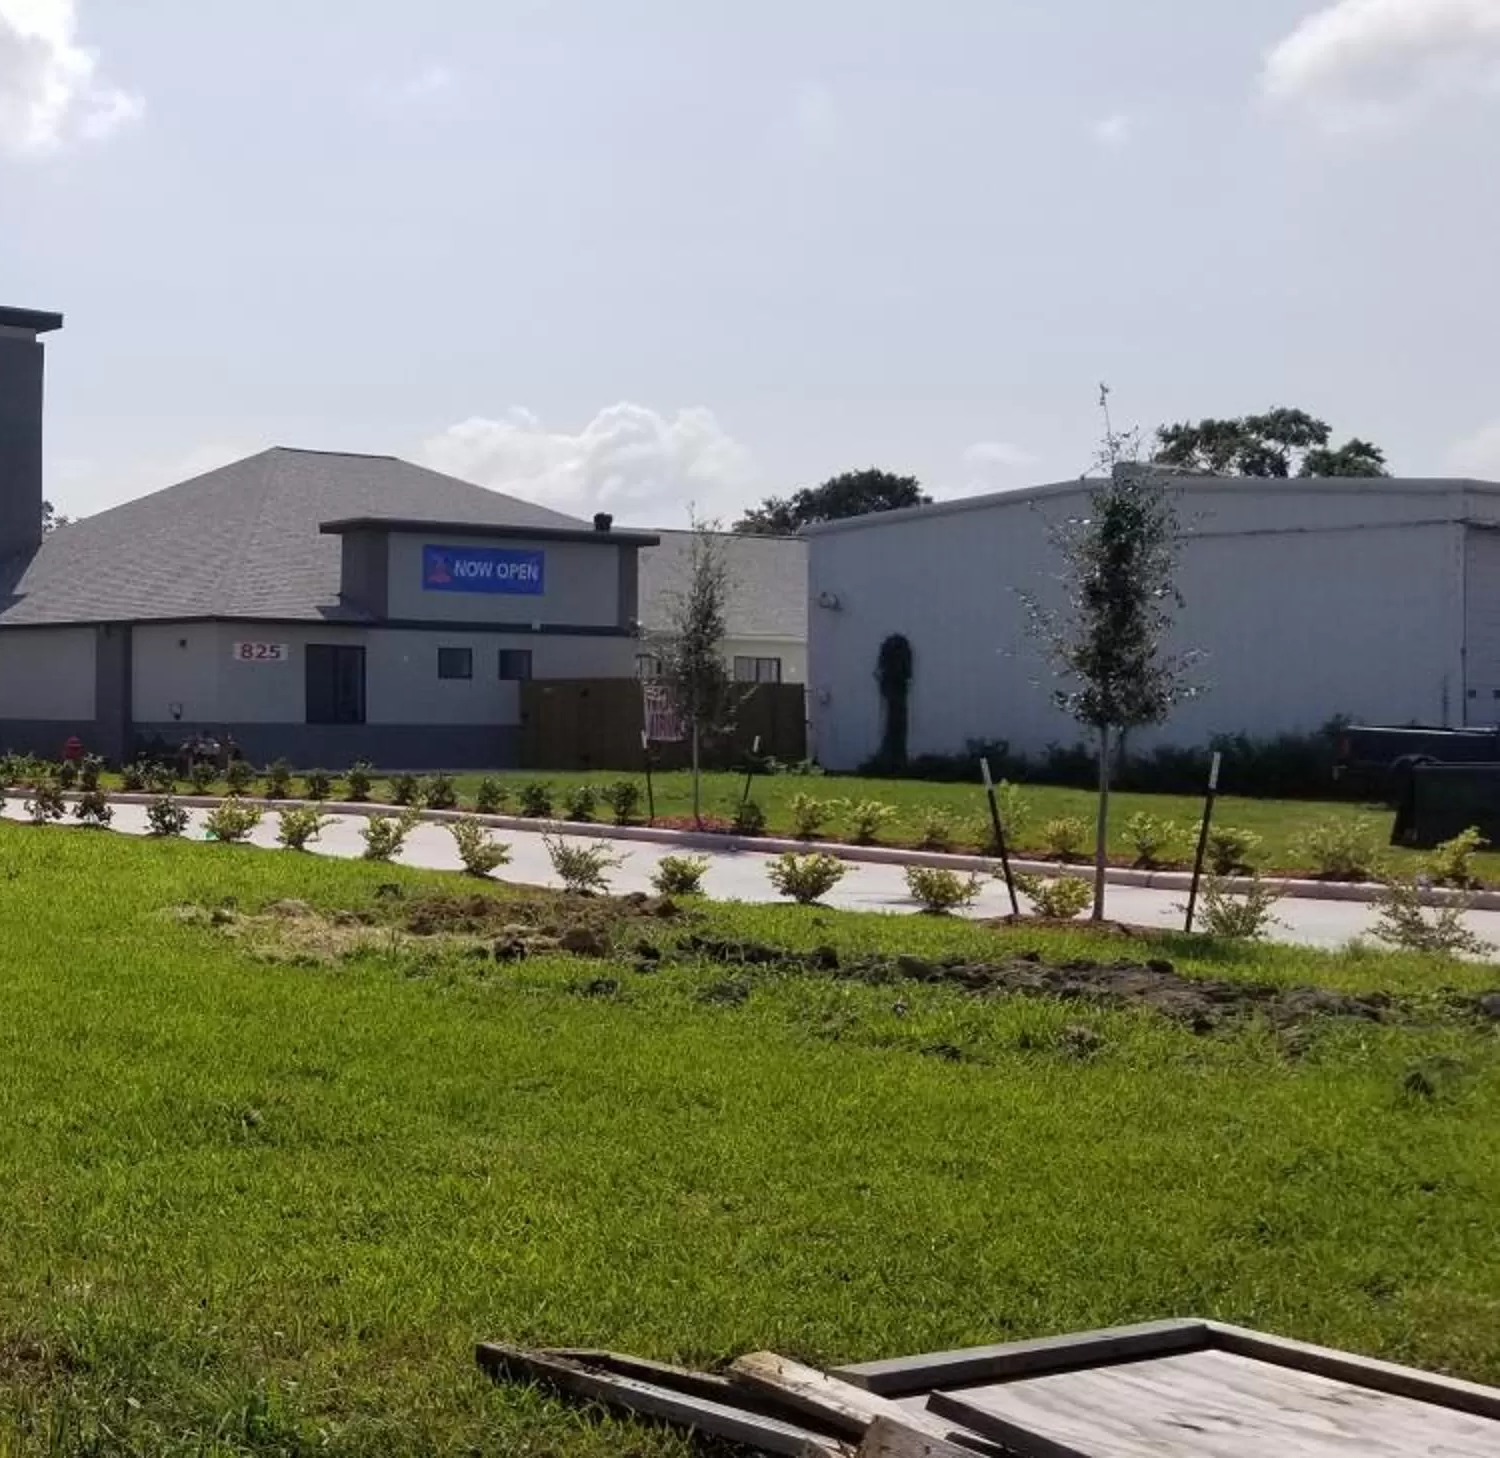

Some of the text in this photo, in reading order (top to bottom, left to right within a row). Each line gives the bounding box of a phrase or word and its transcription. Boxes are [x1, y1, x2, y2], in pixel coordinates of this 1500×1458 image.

[454, 559, 493, 577] NOW
[497, 562, 539, 580] OPEN
[242, 643, 281, 658] 825
